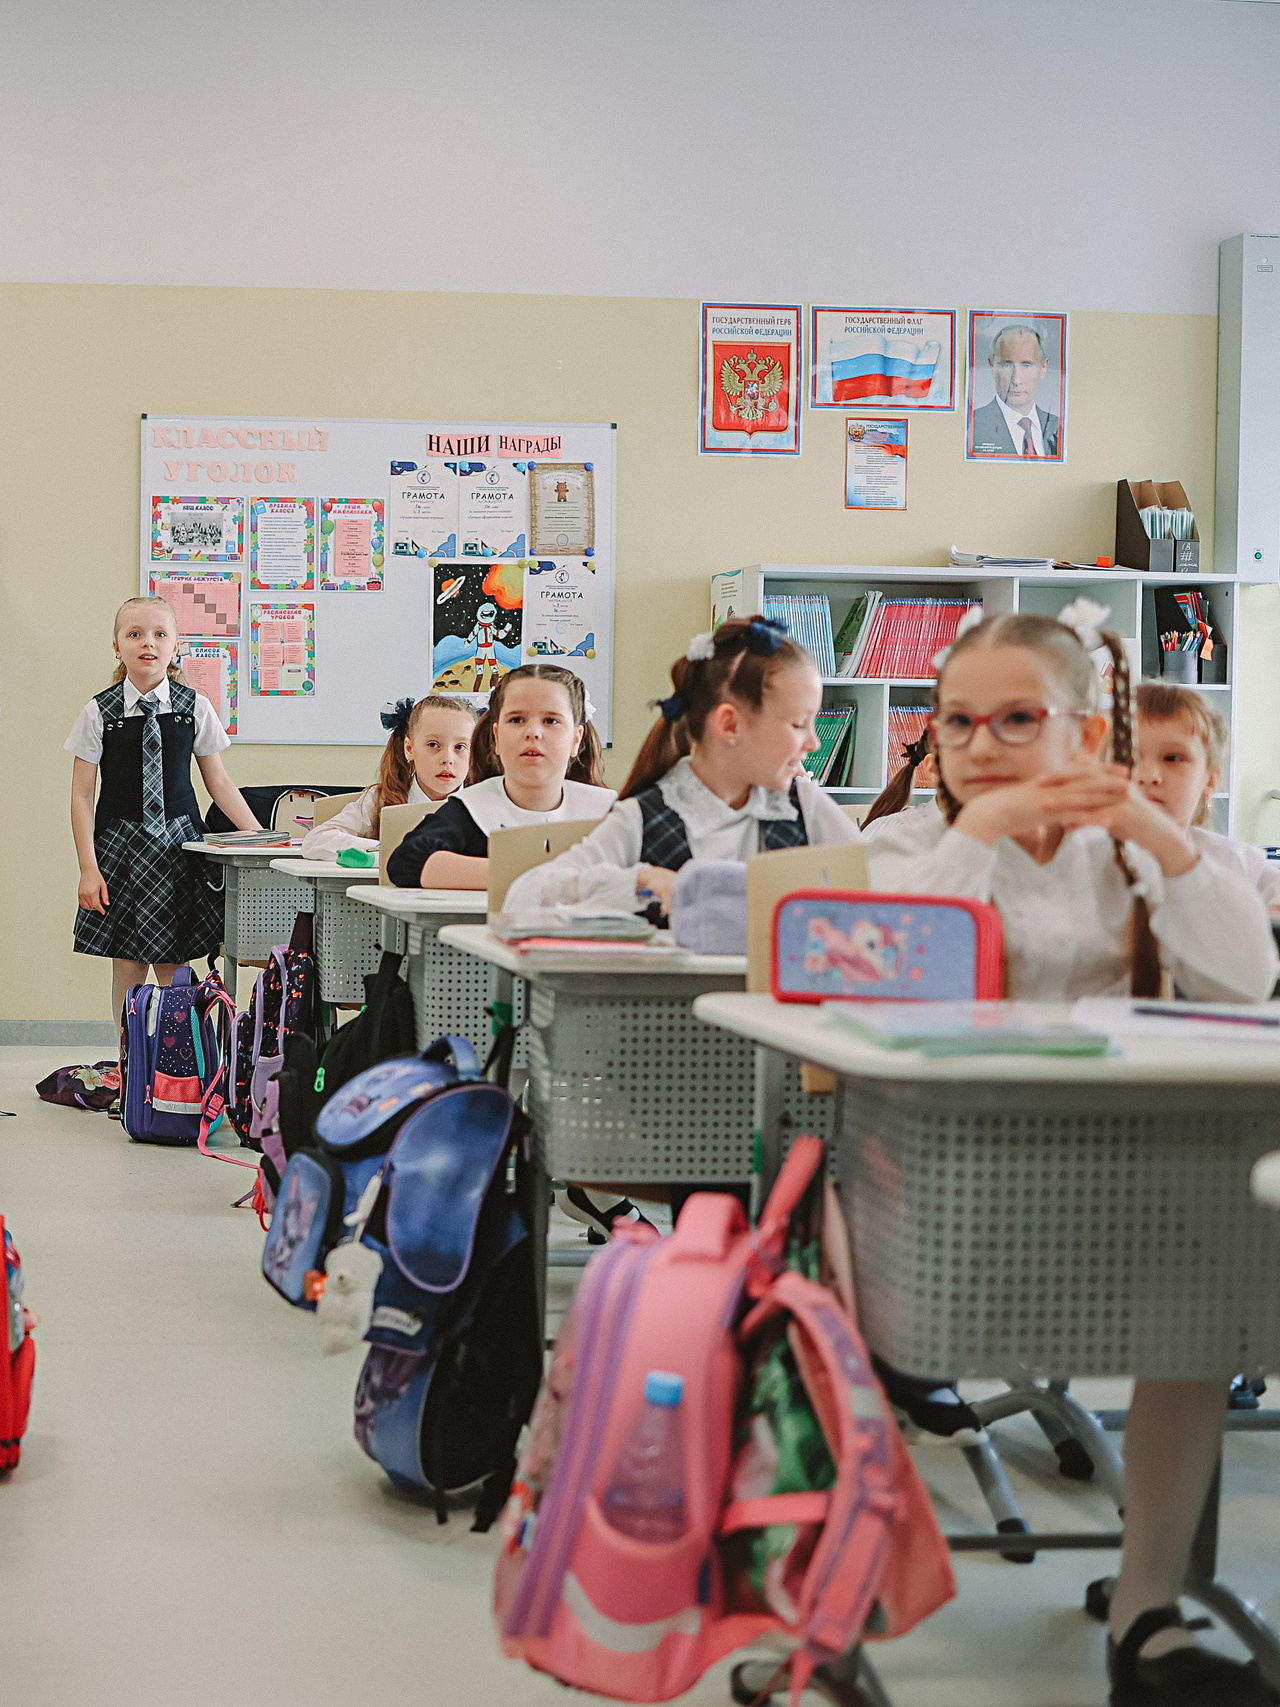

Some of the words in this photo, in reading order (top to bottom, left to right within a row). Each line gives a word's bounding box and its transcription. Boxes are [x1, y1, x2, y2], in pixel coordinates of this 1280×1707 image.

[712, 316, 775, 325] ГОСУДАРСТВЕННЫЙ
[845, 316, 905, 324] ГОСУДАРСТВЕННЫЙ
[712, 326, 753, 335] РОССИЙСКОЙ
[754, 328, 792, 337] ФЕДЕРАЦИИ
[844, 325, 885, 334] РОССИЙСКОЙ
[886, 327, 924, 336] ФЕДЕРАЦИИ
[151, 426, 329, 451] КЛАССНЫЙ
[427, 433, 492, 456] НАШИ
[498, 435, 562, 453] НАГРАДЫ
[163, 460, 297, 484] УГОЛОК
[402, 491, 445, 500] ГРАМОТА
[471, 492, 514, 500] ГРАМОТА
[540, 591, 584, 599] ГРАМОТА
